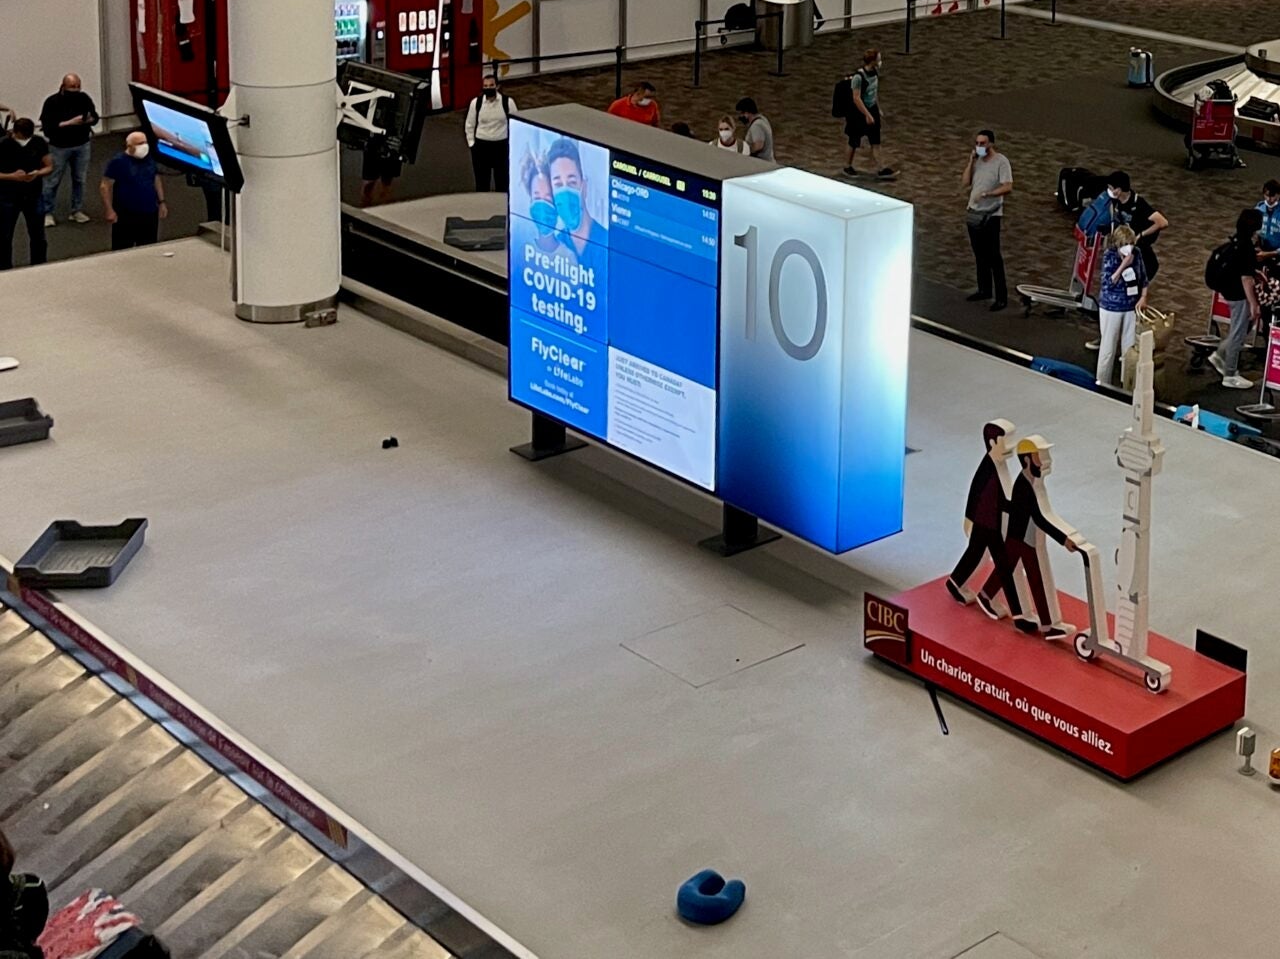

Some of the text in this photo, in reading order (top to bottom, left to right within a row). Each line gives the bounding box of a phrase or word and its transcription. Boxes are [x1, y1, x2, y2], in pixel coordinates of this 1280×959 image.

[525, 243, 595, 287] Pre-flight
[523, 266, 597, 311] COVID-19
[734, 225, 828, 361] 10
[531, 292, 588, 334] testing.
[531, 336, 585, 372] FlyClear
[867, 601, 904, 634] CIBC
[920, 648, 1114, 755] Un chariot gratuit, où que vous alliez.
